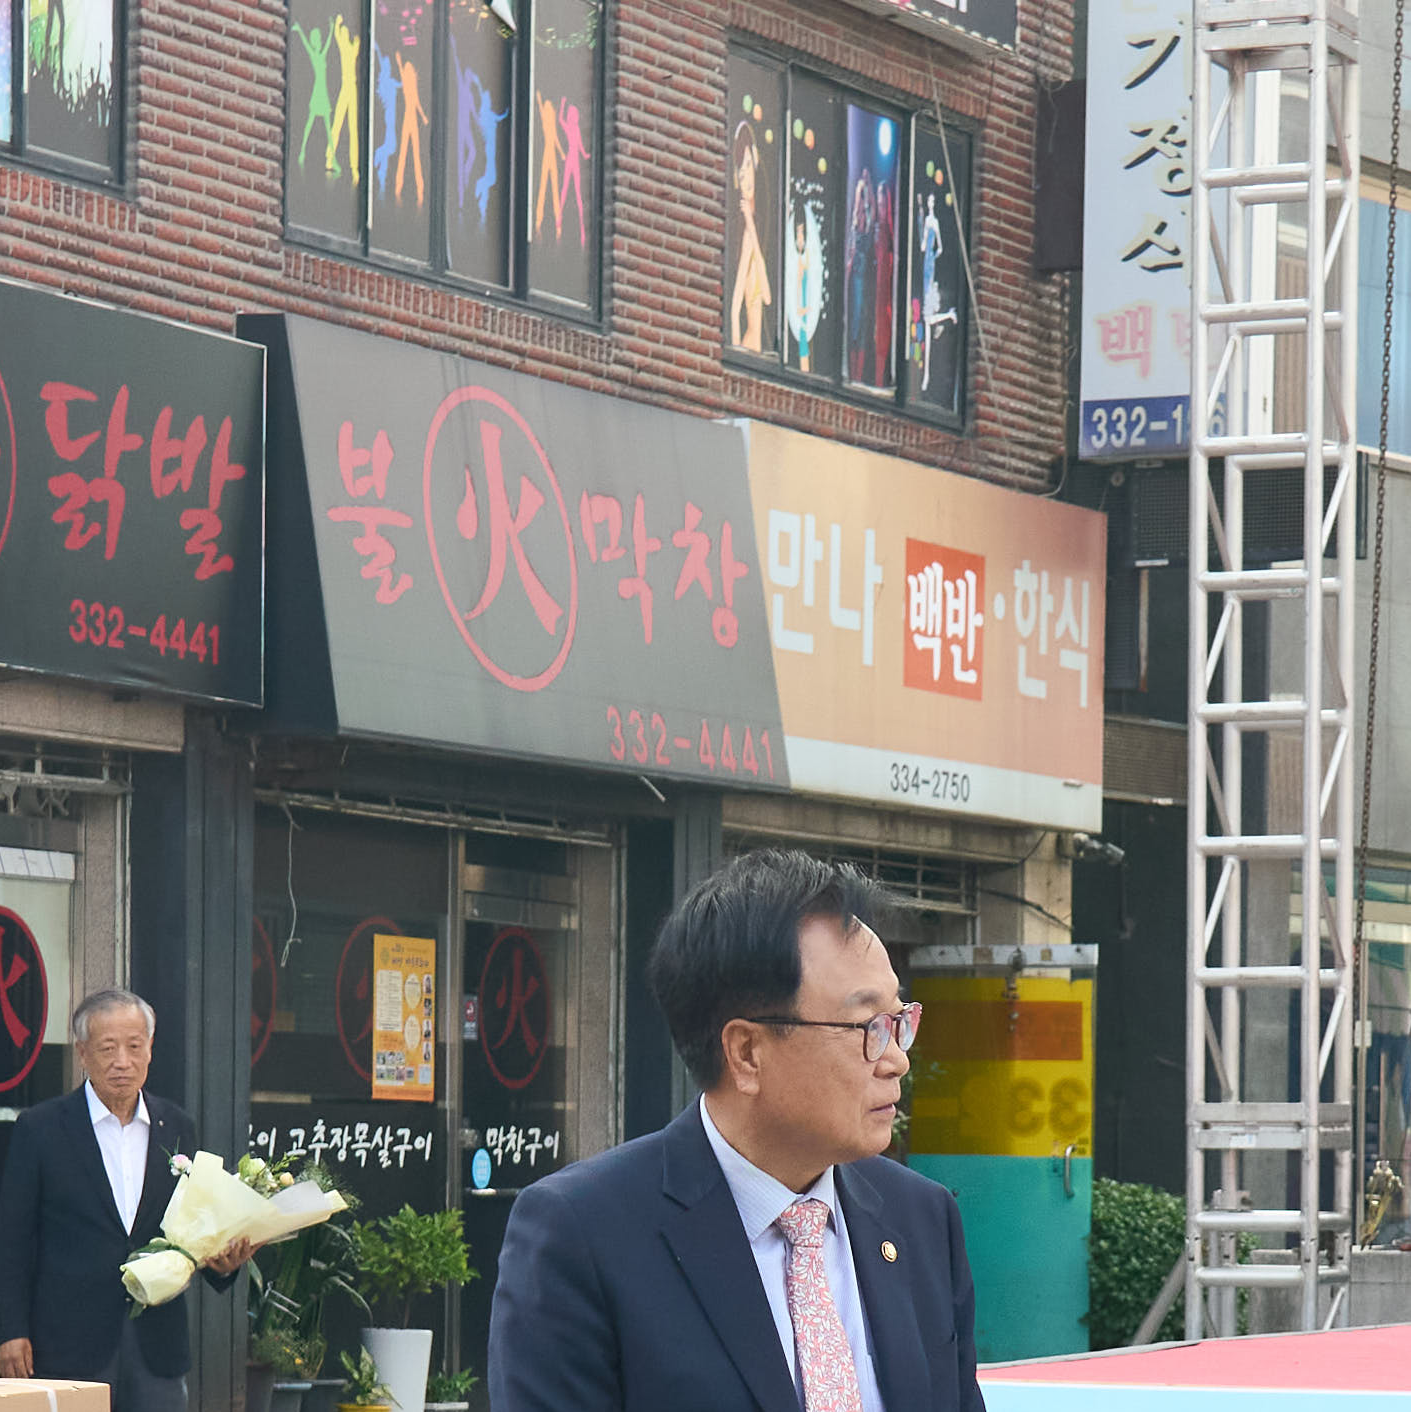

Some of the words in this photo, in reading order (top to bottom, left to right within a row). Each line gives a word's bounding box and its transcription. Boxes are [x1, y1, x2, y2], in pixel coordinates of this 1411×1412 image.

[41, 381, 245, 581] 닭발
[326, 420, 413, 604] 불
[456, 420, 563, 637] 火
[580, 491, 749, 649] 막창
[69, 599, 221, 666] 332-4441
[768, 508, 883, 667] 만나
[908, 561, 984, 687] 백반
[1014, 559, 1089, 709] 한식
[606, 704, 775, 780] 332-4441
[890, 762, 972, 803] 334-2750
[286, 1119, 433, 1169] 고추장목살구이
[486, 1124, 560, 1168] 막창구이
